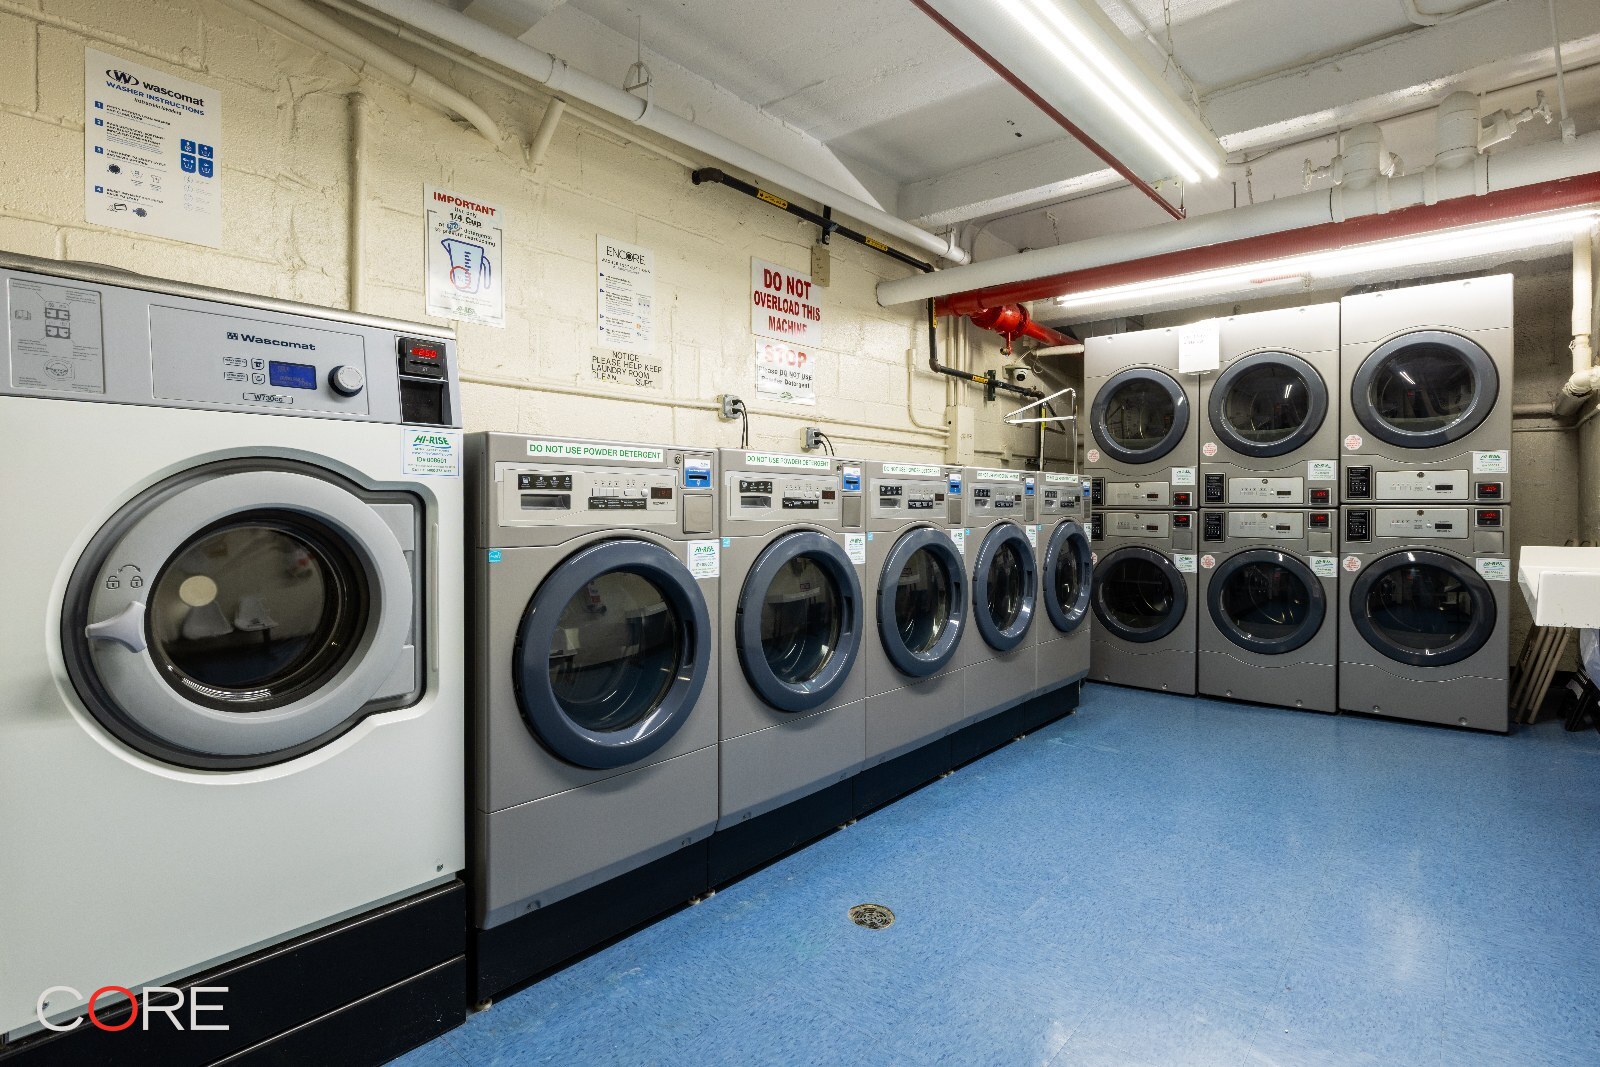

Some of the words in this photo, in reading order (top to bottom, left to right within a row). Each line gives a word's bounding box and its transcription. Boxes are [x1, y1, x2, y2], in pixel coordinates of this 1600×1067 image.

[106, 80, 145, 98] WASHER
[146, 93, 205, 116] INSTRUCTIONS
[142, 81, 204, 107] wascomat
[433, 191, 496, 216] IMPORTANT
[450, 213, 462, 222] 1/4
[465, 216, 482, 228] Cup
[606, 245, 645, 266] ENCORE
[763, 267, 783, 292] DO
[786, 275, 812, 300] NOT
[753, 290, 800, 317] OVERLOAD
[802, 303, 821, 322] THIS
[768, 315, 808, 338] MACHINE
[240, 333, 316, 351] Wascomat
[592, 355, 621, 367] PLEASE
[623, 360, 643, 370] HELP
[644, 363, 663, 374] KEEP
[612, 350, 640, 362] NOTICE
[764, 344, 807, 368] STOP
[591, 363, 627, 375] LAUNDRY
[628, 369, 650, 380] ROOM
[414, 435, 450, 445] HI-RISE
[529, 444, 543, 452] DO
[545, 445, 563, 454] NOT
[565, 446, 582, 455] USE
[583, 447, 618, 457] POWDER
[619, 449, 661, 459] DETERGENT
[768, 456, 780, 464] USE
